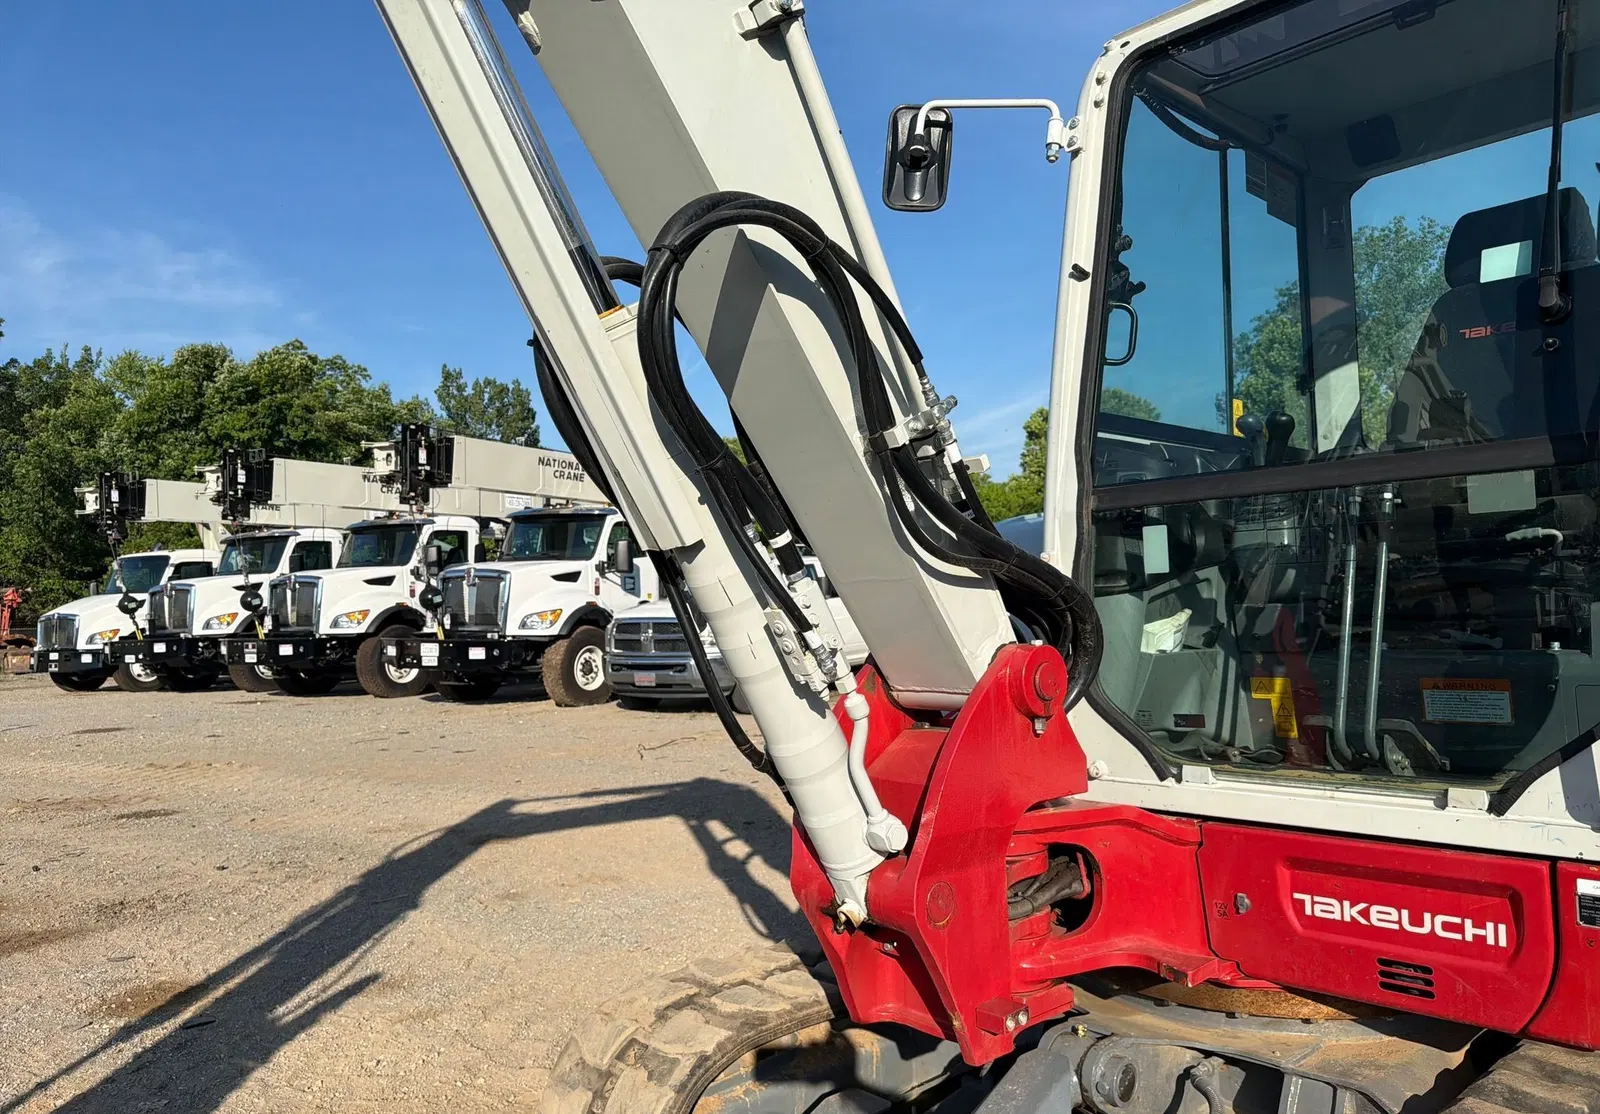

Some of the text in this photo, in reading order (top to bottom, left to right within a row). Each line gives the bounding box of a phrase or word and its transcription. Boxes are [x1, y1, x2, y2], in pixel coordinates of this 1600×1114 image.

[553, 469, 585, 482] CRANE
[380, 484, 401, 495] CRA
[1442, 682, 1497, 690] WARNING
[1214, 902, 1229, 910] 12V
[1217, 910, 1229, 918] 5A
